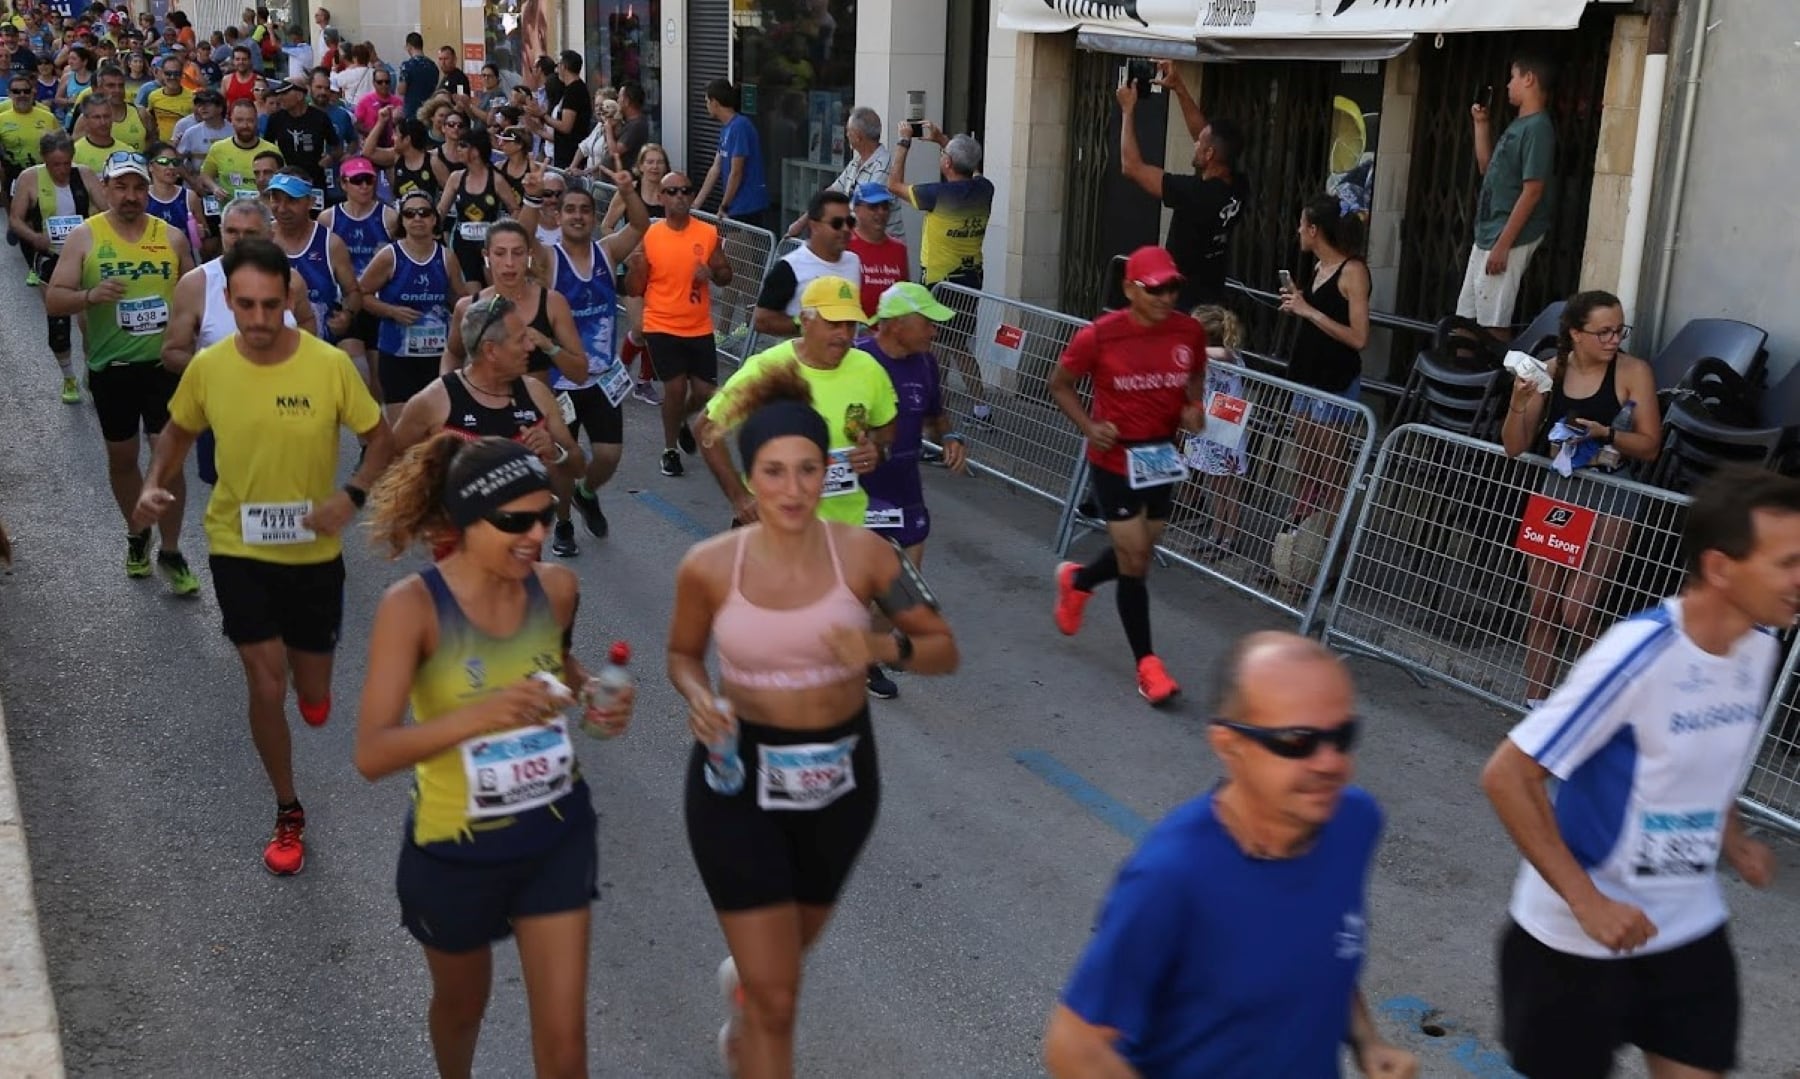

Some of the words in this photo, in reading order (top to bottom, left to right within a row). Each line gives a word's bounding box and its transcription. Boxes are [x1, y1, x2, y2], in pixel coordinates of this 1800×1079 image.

[400, 292, 446, 301] ondara
[136, 311, 157, 323] 638
[511, 757, 550, 783] 103
